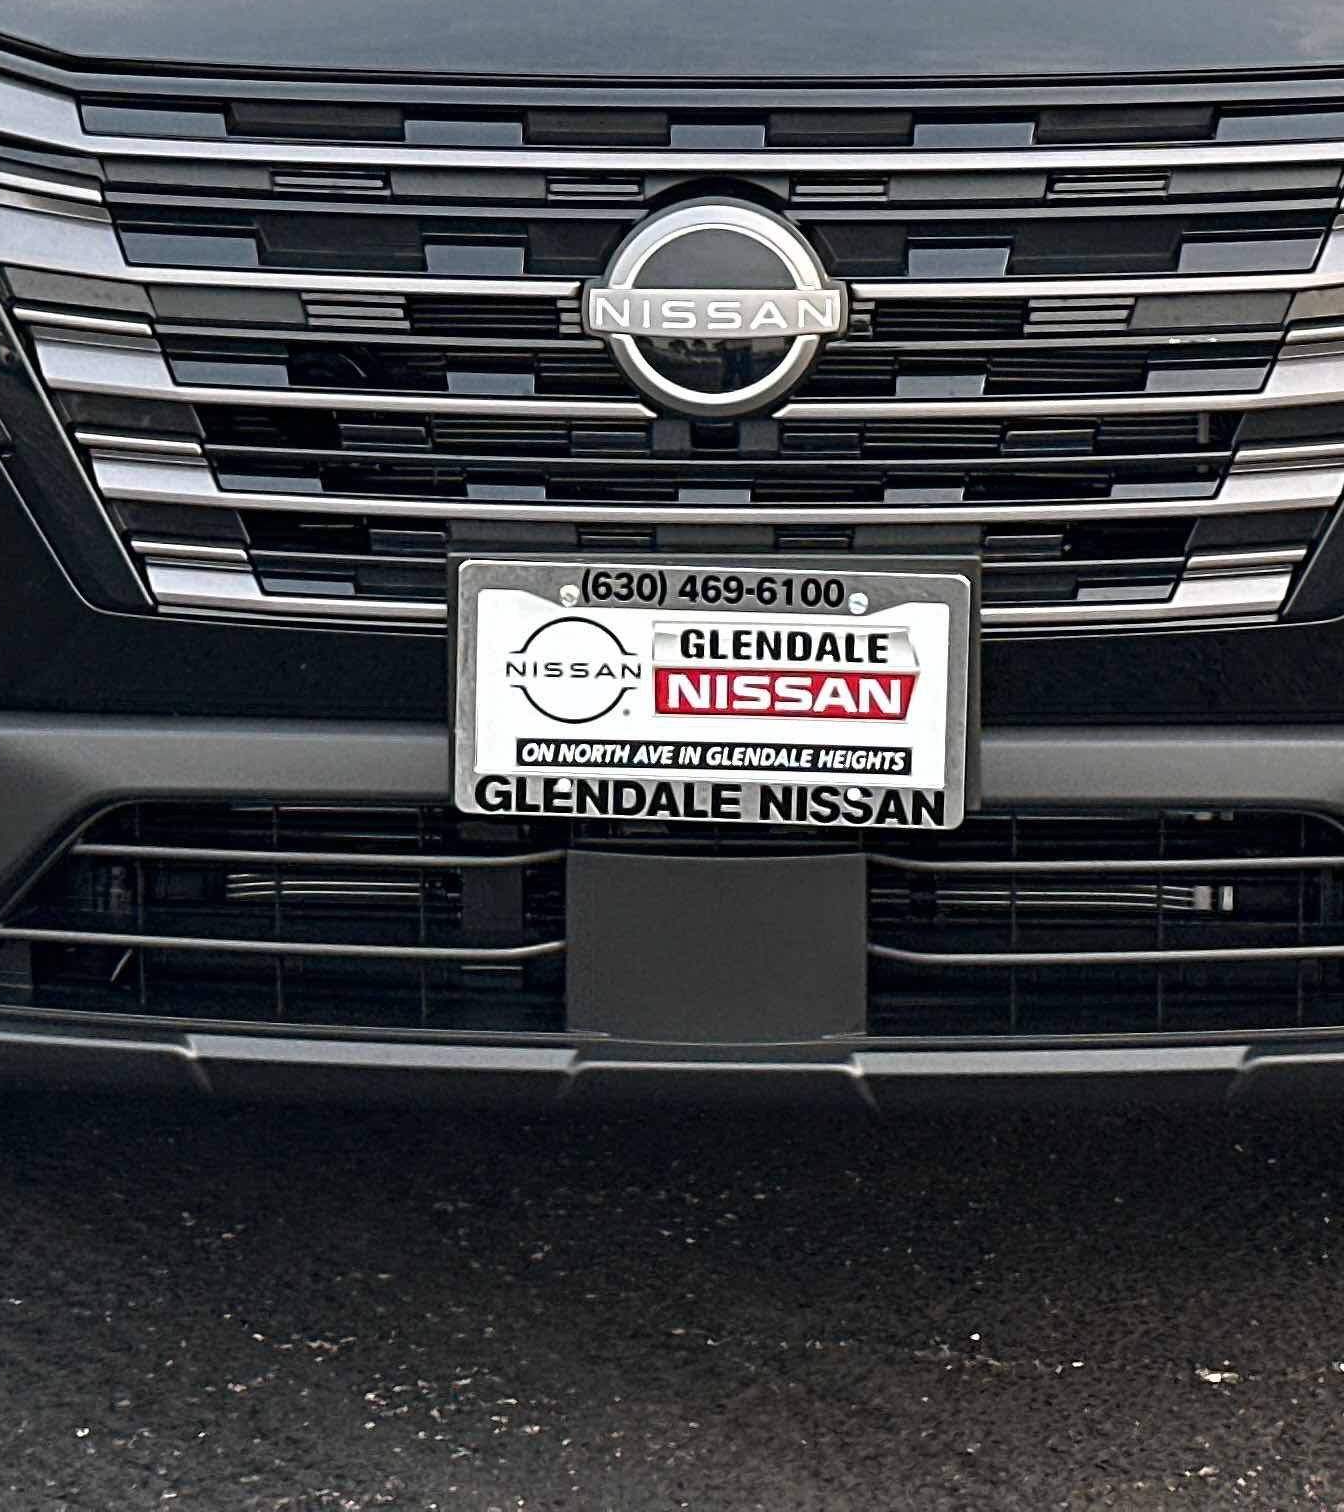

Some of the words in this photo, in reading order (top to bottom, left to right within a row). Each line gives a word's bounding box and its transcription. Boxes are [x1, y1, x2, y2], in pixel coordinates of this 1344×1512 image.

[595, 297, 834, 330] NISSAN
[581, 568, 667, 606] (630)
[678, 573, 845, 609] 469-6100
[679, 628, 890, 664] GLENDALE
[506, 661, 642, 679] NISSAN
[667, 673, 902, 715] NISSAN
[521, 742, 556, 763] ON
[557, 743, 631, 764] NORTH
[633, 745, 675, 765] AVE
[678, 746, 702, 766] IN
[706, 746, 814, 769] GLENDALE
[817, 749, 906, 772] HEIGHTS
[475, 774, 742, 820] GLENDALE
[759, 784, 945, 826] NISSAN
